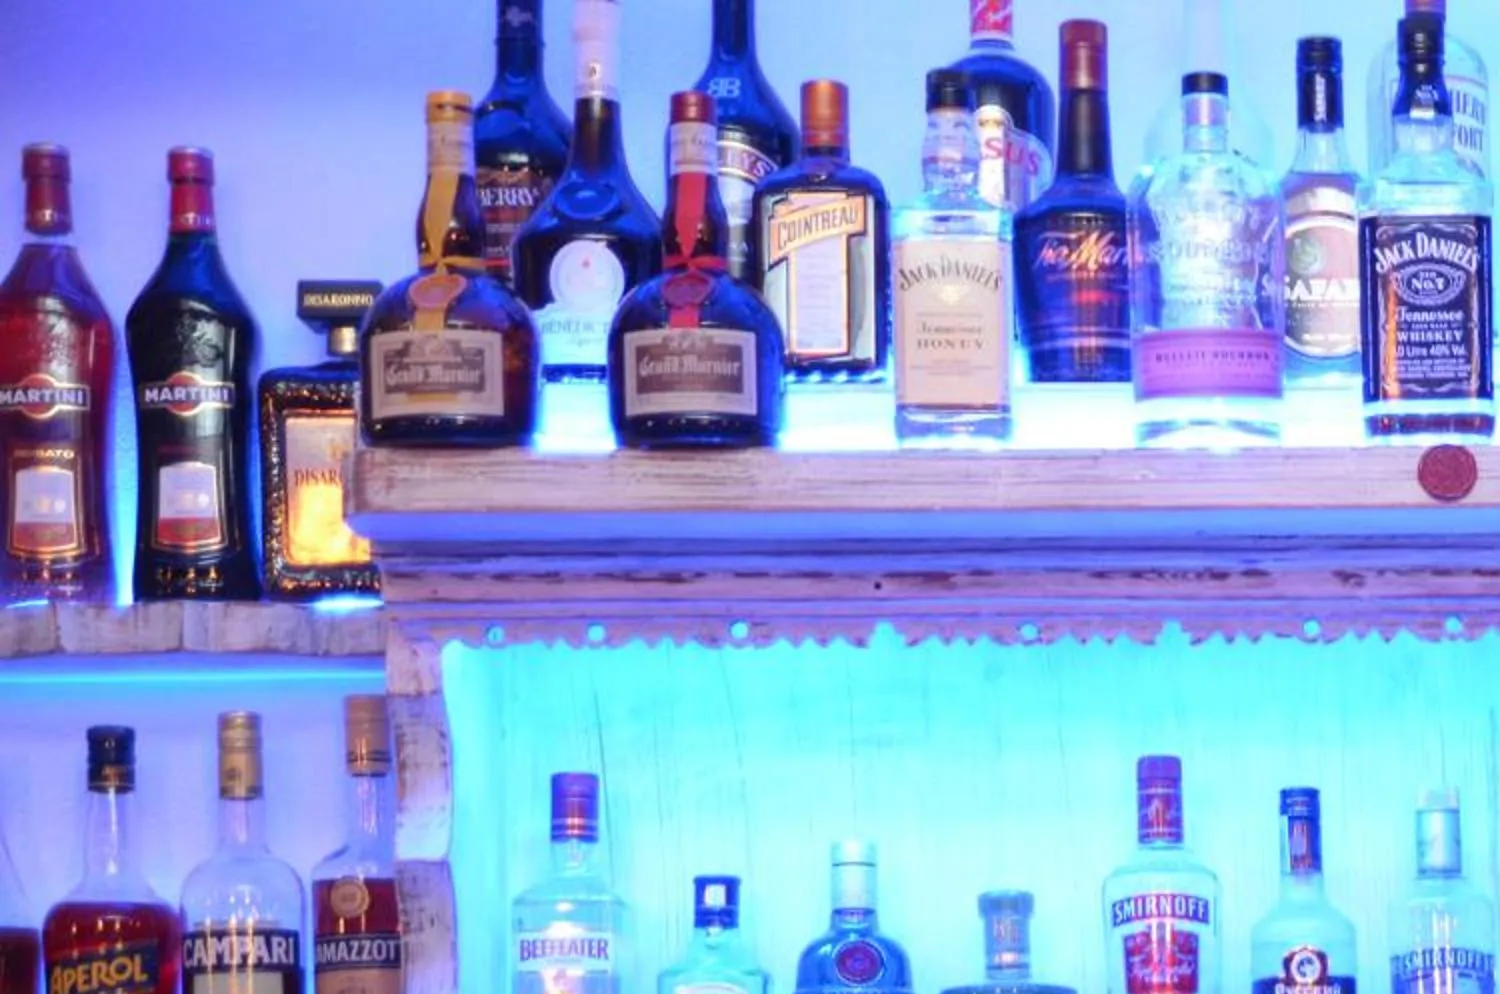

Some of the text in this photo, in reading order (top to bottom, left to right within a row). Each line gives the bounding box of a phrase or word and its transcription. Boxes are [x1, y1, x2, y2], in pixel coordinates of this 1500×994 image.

[776, 206, 859, 251] COINTREAU
[1374, 239, 1415, 273] JACK
[898, 262, 936, 292] JACK
[0, 386, 84, 405] MARTINI
[145, 385, 229, 402] MARTINI
[1114, 894, 1208, 923] SMIRNOFF
[183, 936, 296, 969] CAMPARI
[519, 937, 609, 962] BEEFEATER
